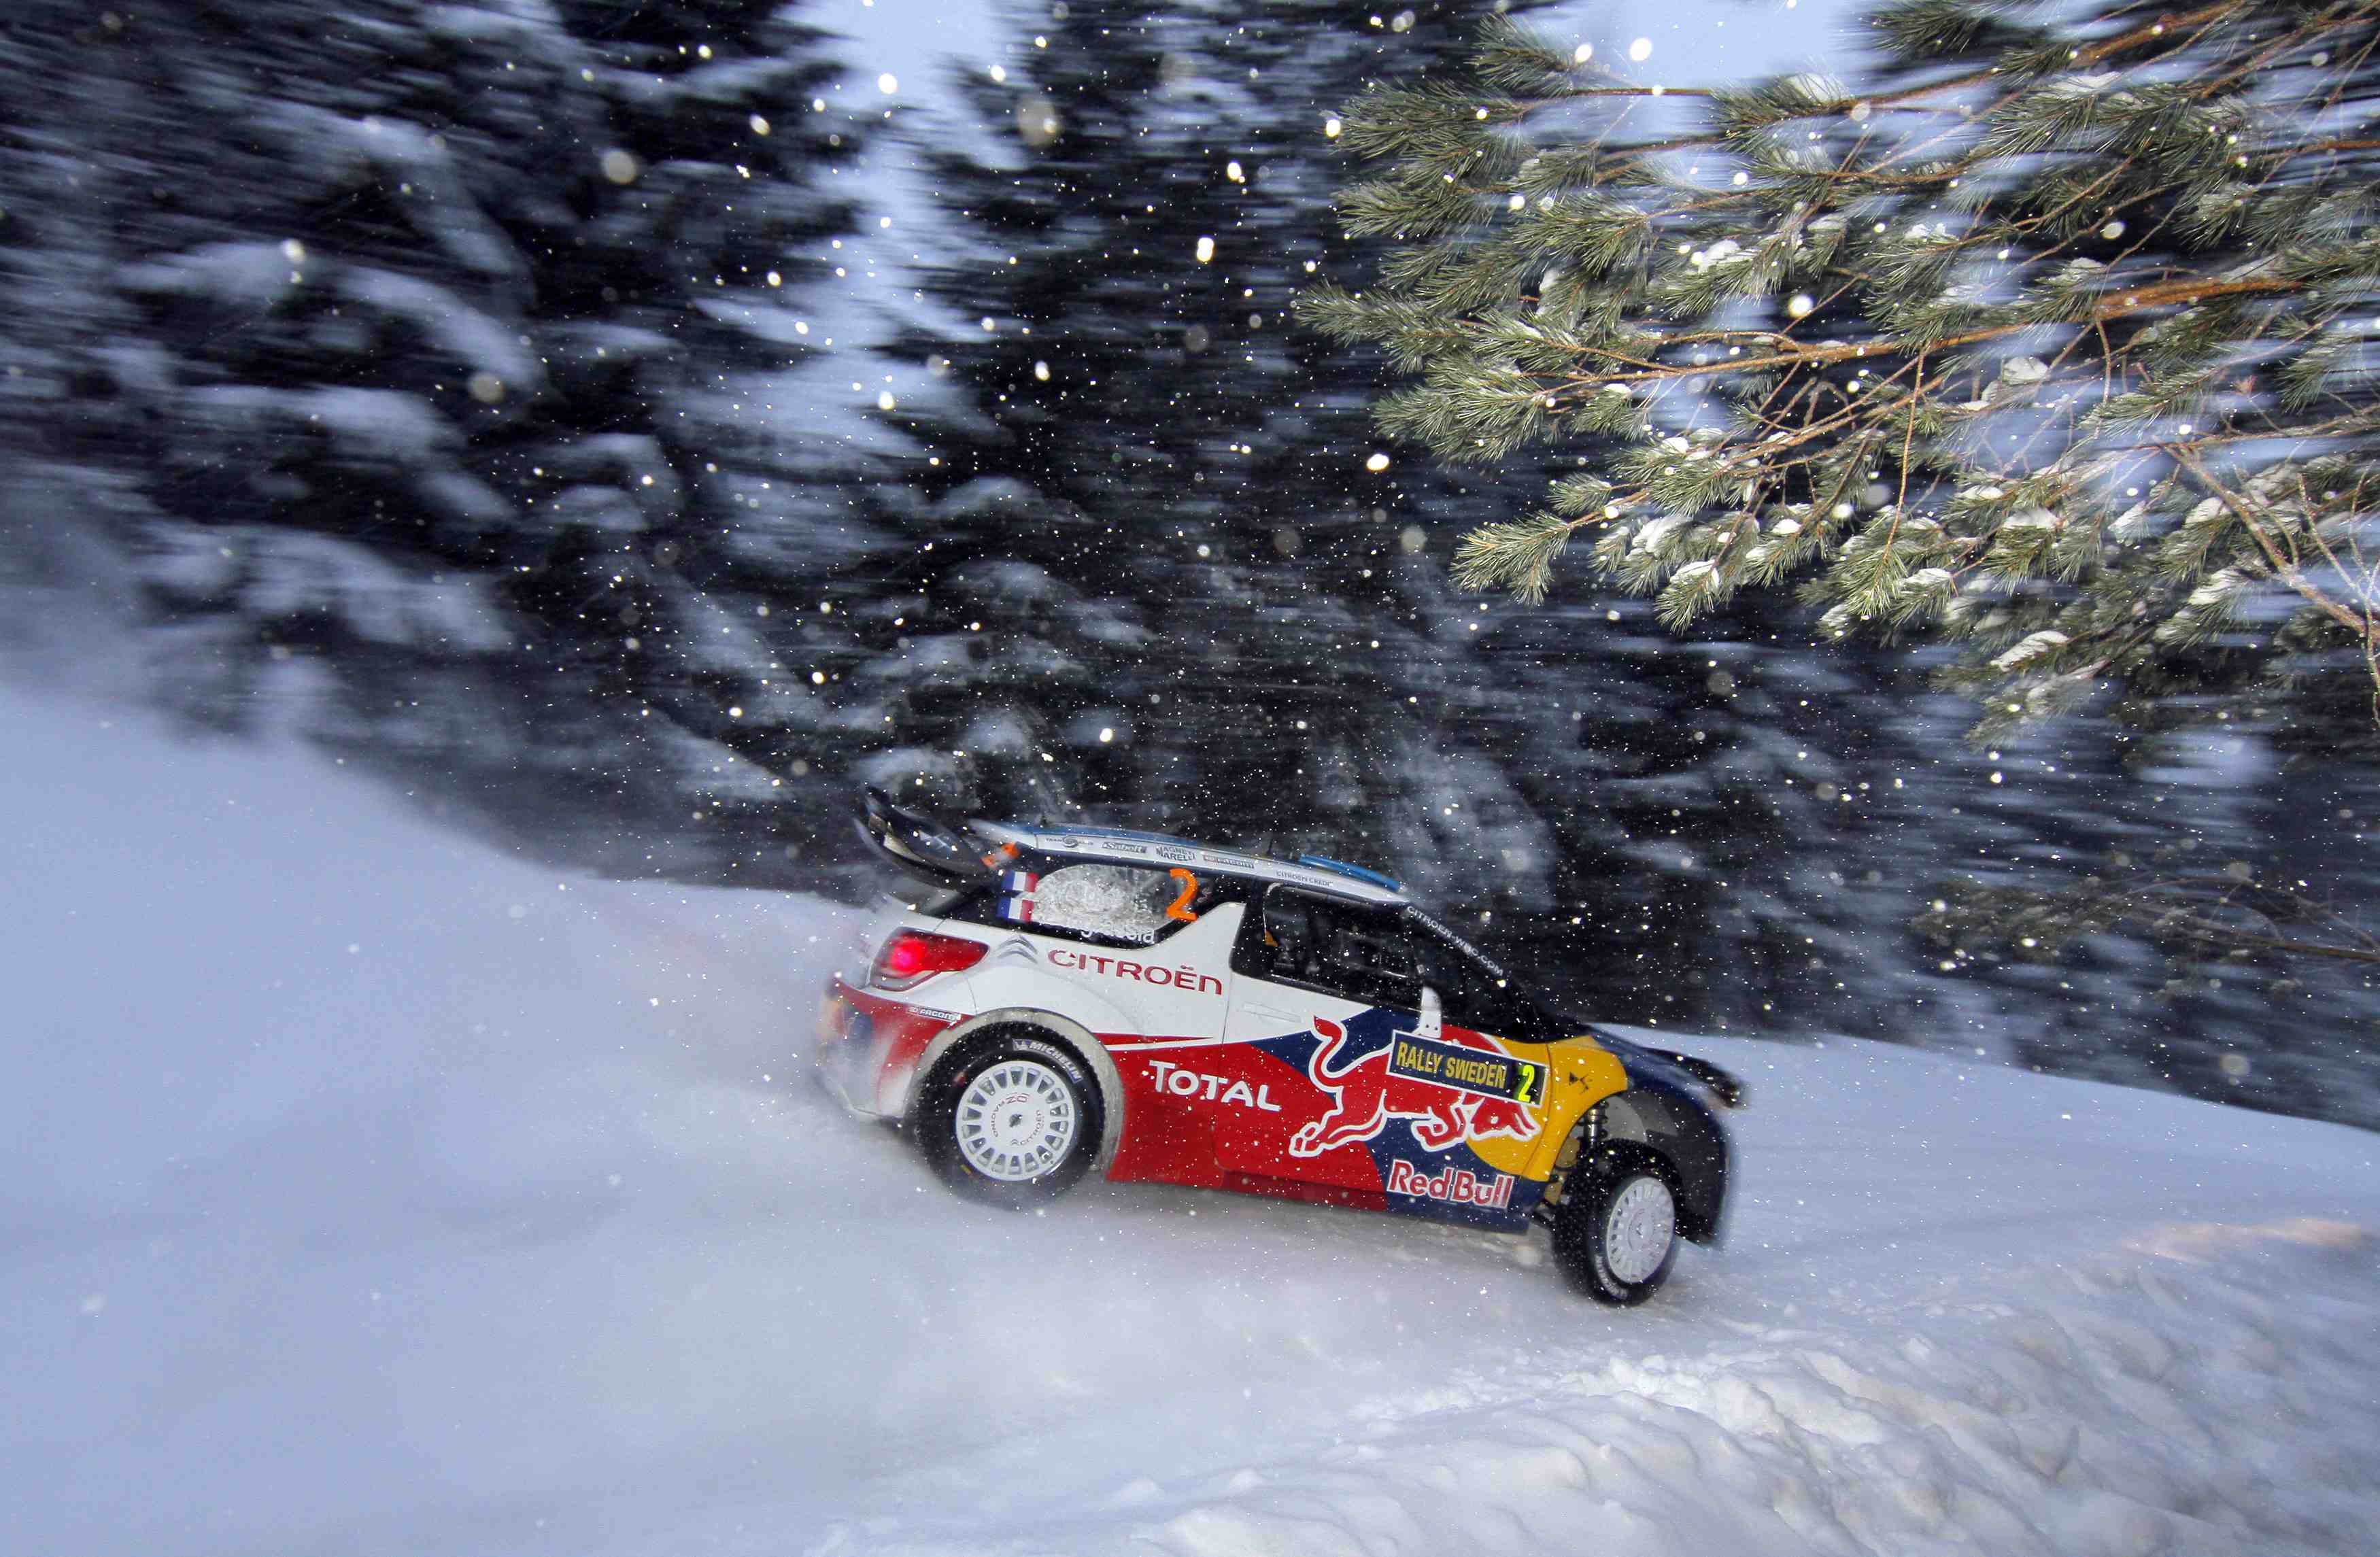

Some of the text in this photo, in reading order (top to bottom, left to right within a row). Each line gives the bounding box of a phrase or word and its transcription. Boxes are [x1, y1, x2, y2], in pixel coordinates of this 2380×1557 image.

[1166, 867, 1197, 921] 2
[1029, 1040, 1083, 1080] MICHELIN
[1396, 1041, 1508, 1089] RALLY SWEDEN
[1518, 1064, 1535, 1102] 2
[1149, 1059, 1282, 1112] TOTAL
